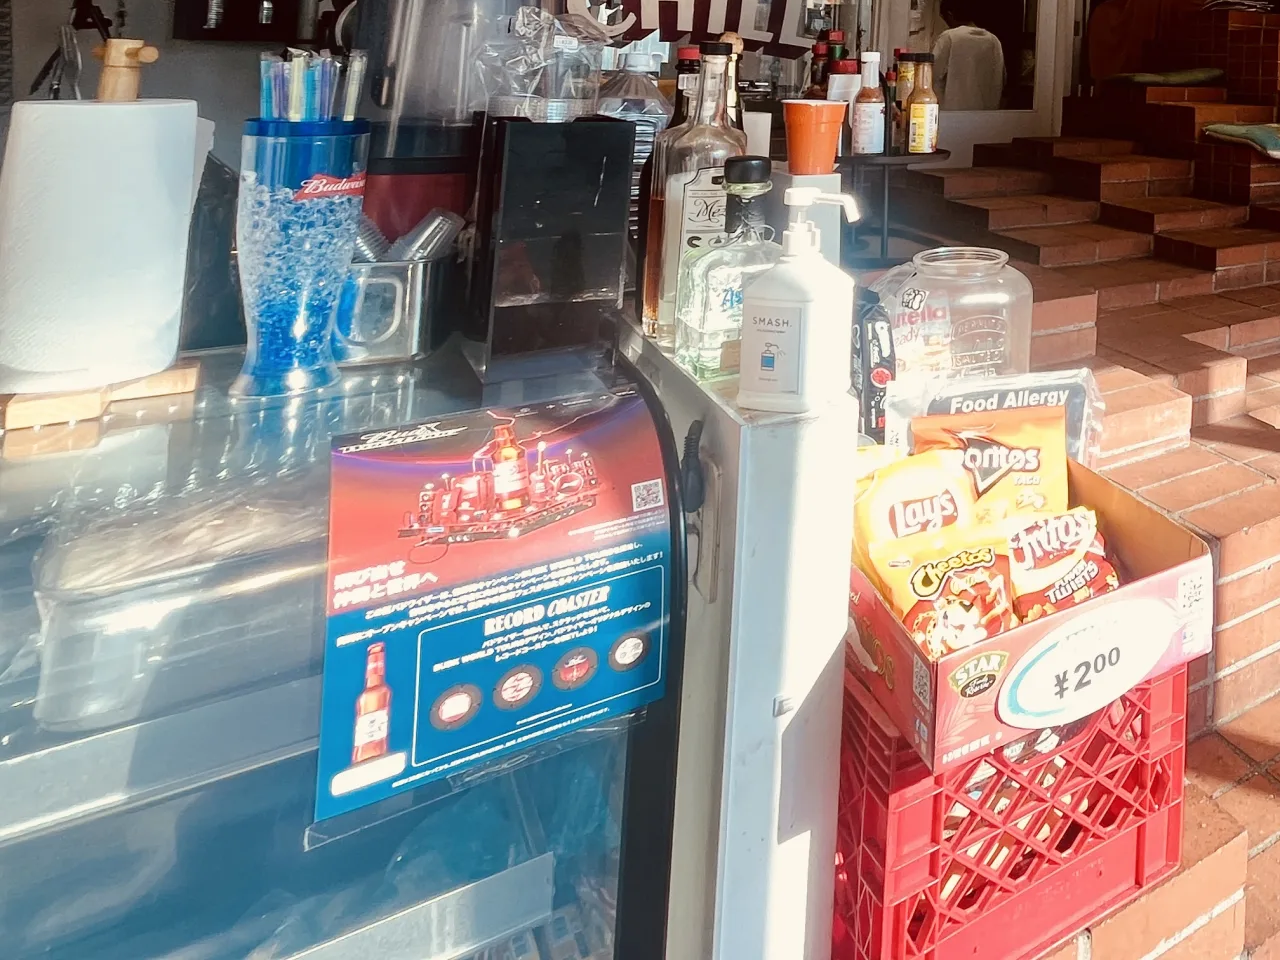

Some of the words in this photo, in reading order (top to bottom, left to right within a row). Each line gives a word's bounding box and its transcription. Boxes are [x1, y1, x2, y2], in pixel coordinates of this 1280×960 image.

[950, 395, 999, 415] Food
[1002, 389, 1071, 411] Allergy
[911, 547, 993, 597] Cheetos
[484, 604, 546, 637] RECORD
[547, 585, 612, 619] COASTER
[1053, 646, 1121, 699] ¥200
